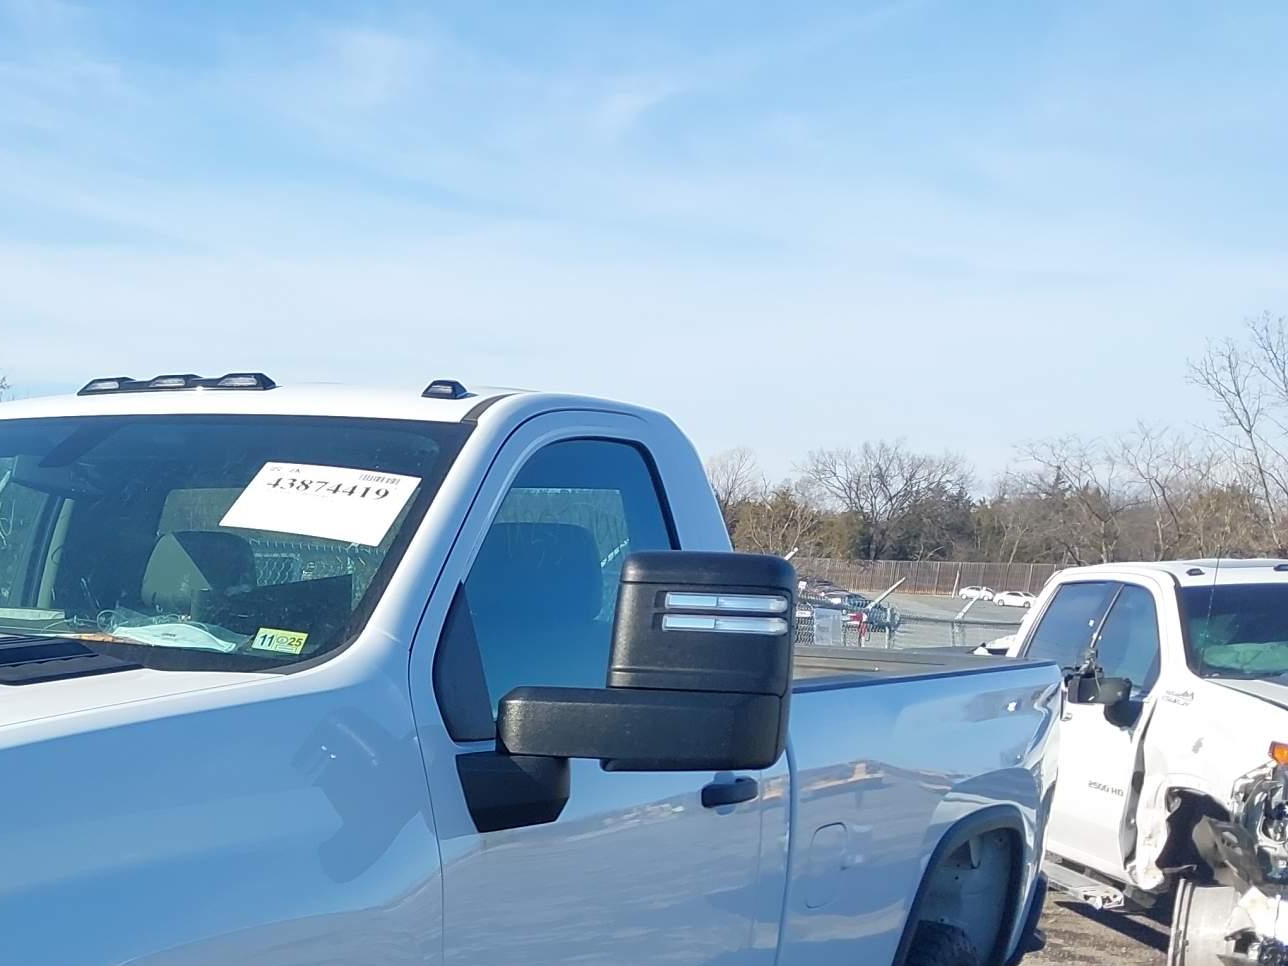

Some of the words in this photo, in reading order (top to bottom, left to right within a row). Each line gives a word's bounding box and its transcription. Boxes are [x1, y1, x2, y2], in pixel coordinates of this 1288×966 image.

[266, 476, 390, 501] 43874419
[259, 633, 276, 648] 11
[286, 636, 304, 648] 25
